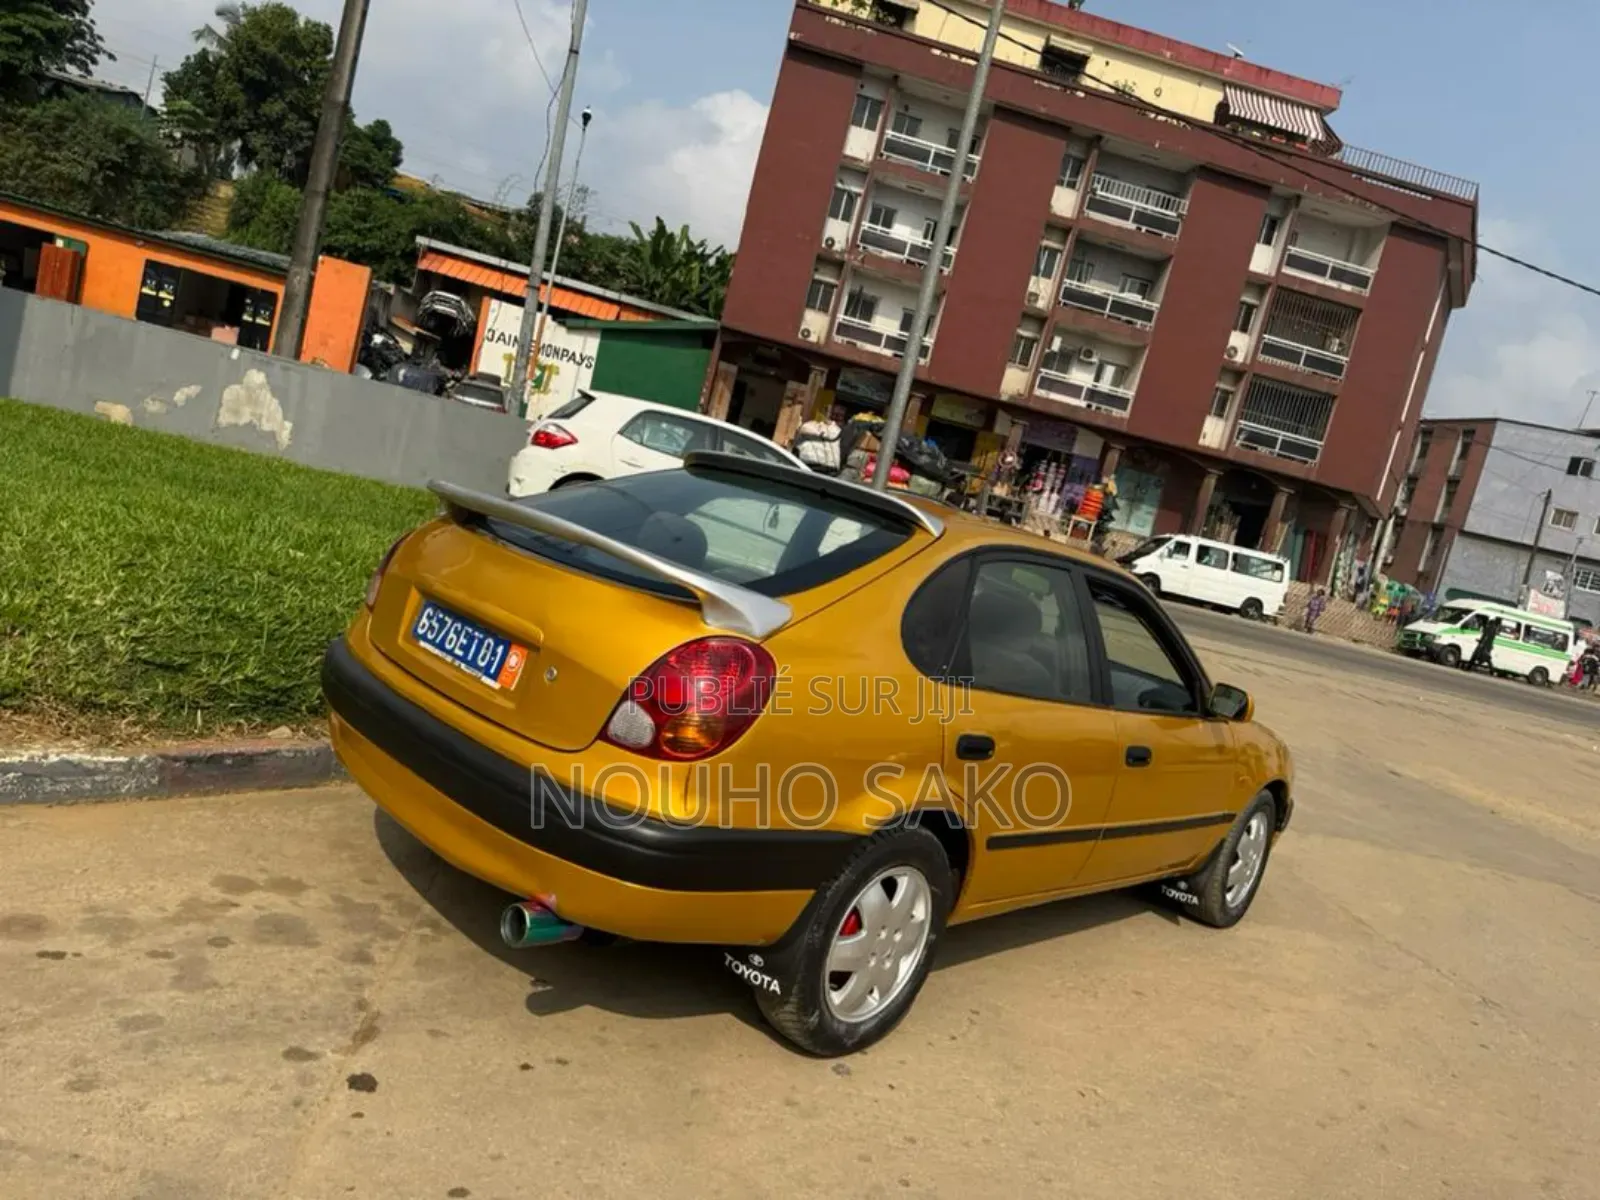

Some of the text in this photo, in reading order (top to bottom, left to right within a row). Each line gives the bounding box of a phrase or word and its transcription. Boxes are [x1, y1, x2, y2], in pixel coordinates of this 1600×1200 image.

[417, 607, 504, 674] 6576ET01
[1161, 884, 1199, 905] TOYOTA
[724, 952, 781, 995] TOYOTA
